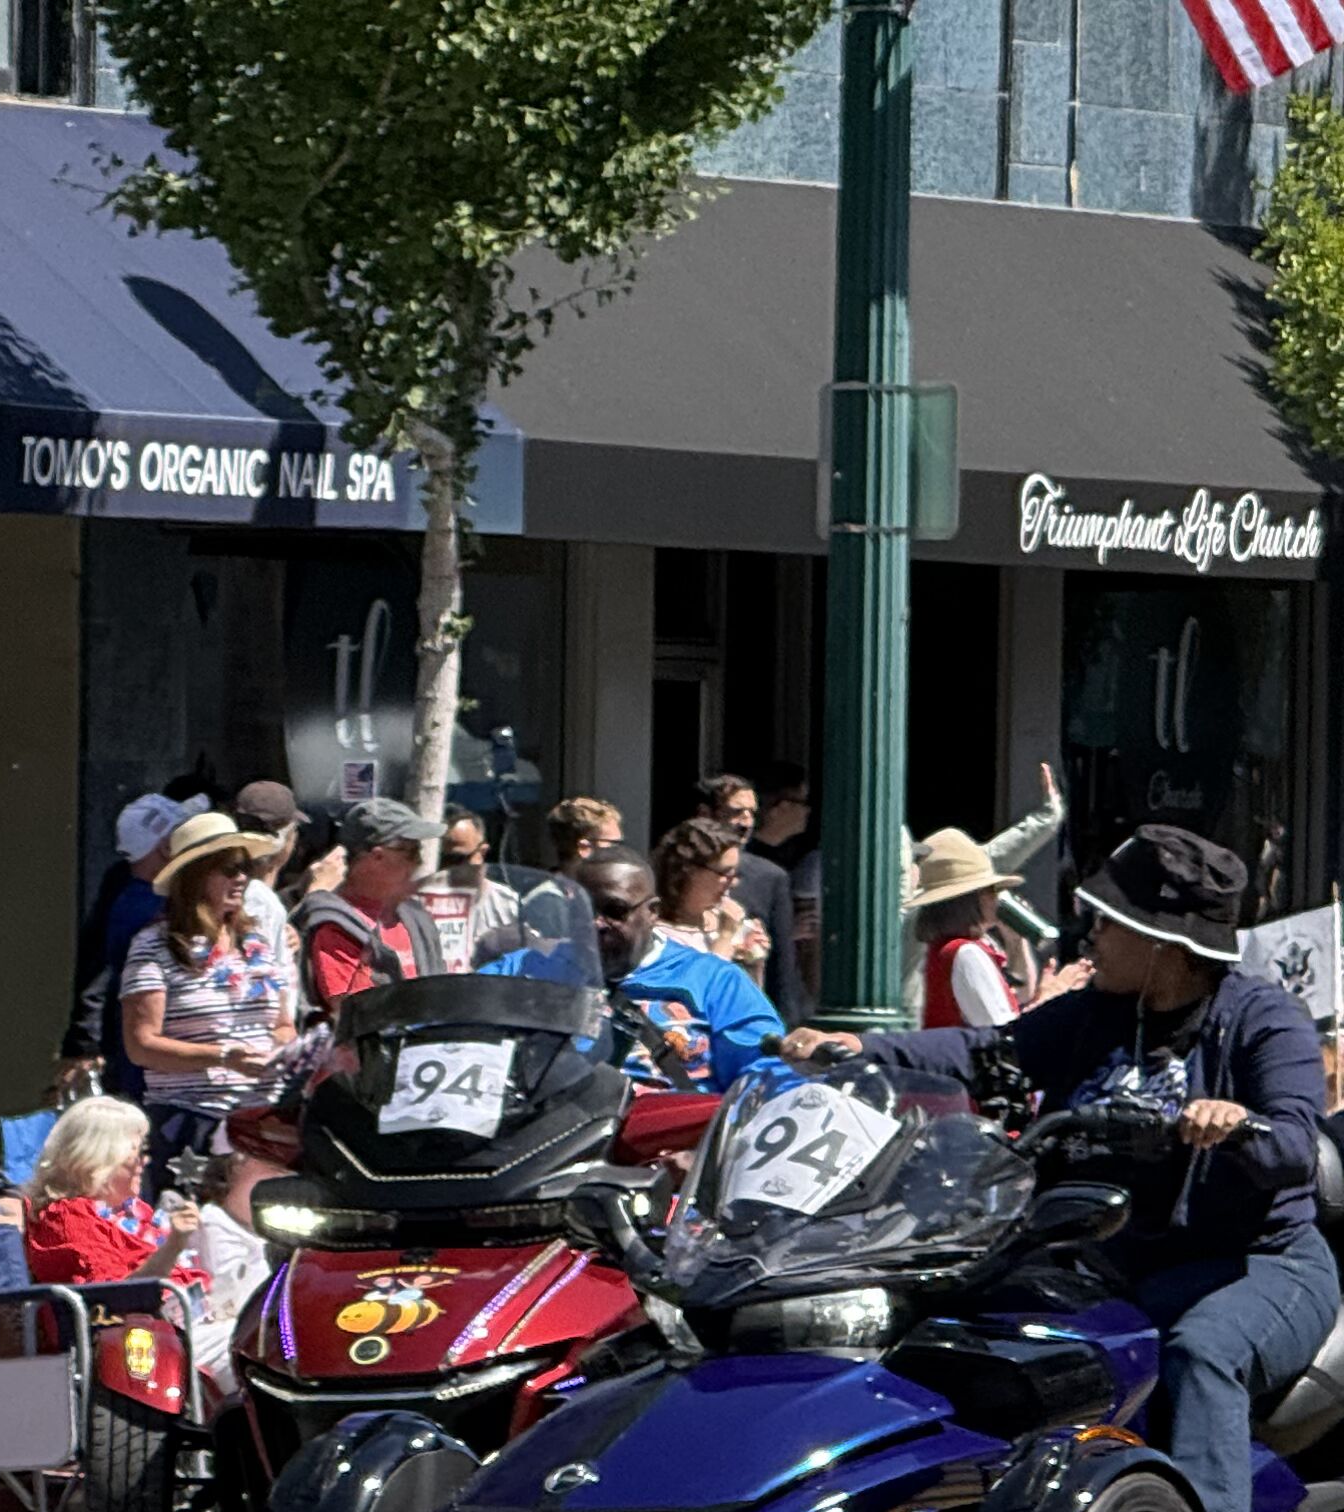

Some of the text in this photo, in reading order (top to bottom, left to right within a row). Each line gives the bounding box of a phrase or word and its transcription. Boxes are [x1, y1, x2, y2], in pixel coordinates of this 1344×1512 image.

[23, 436, 396, 502] TOMO'S ORGANIC NAIL SPA
[1020, 472, 1323, 572] Triumphant Life Church
[409, 1059, 485, 1106] 94
[745, 1115, 849, 1187] 94
